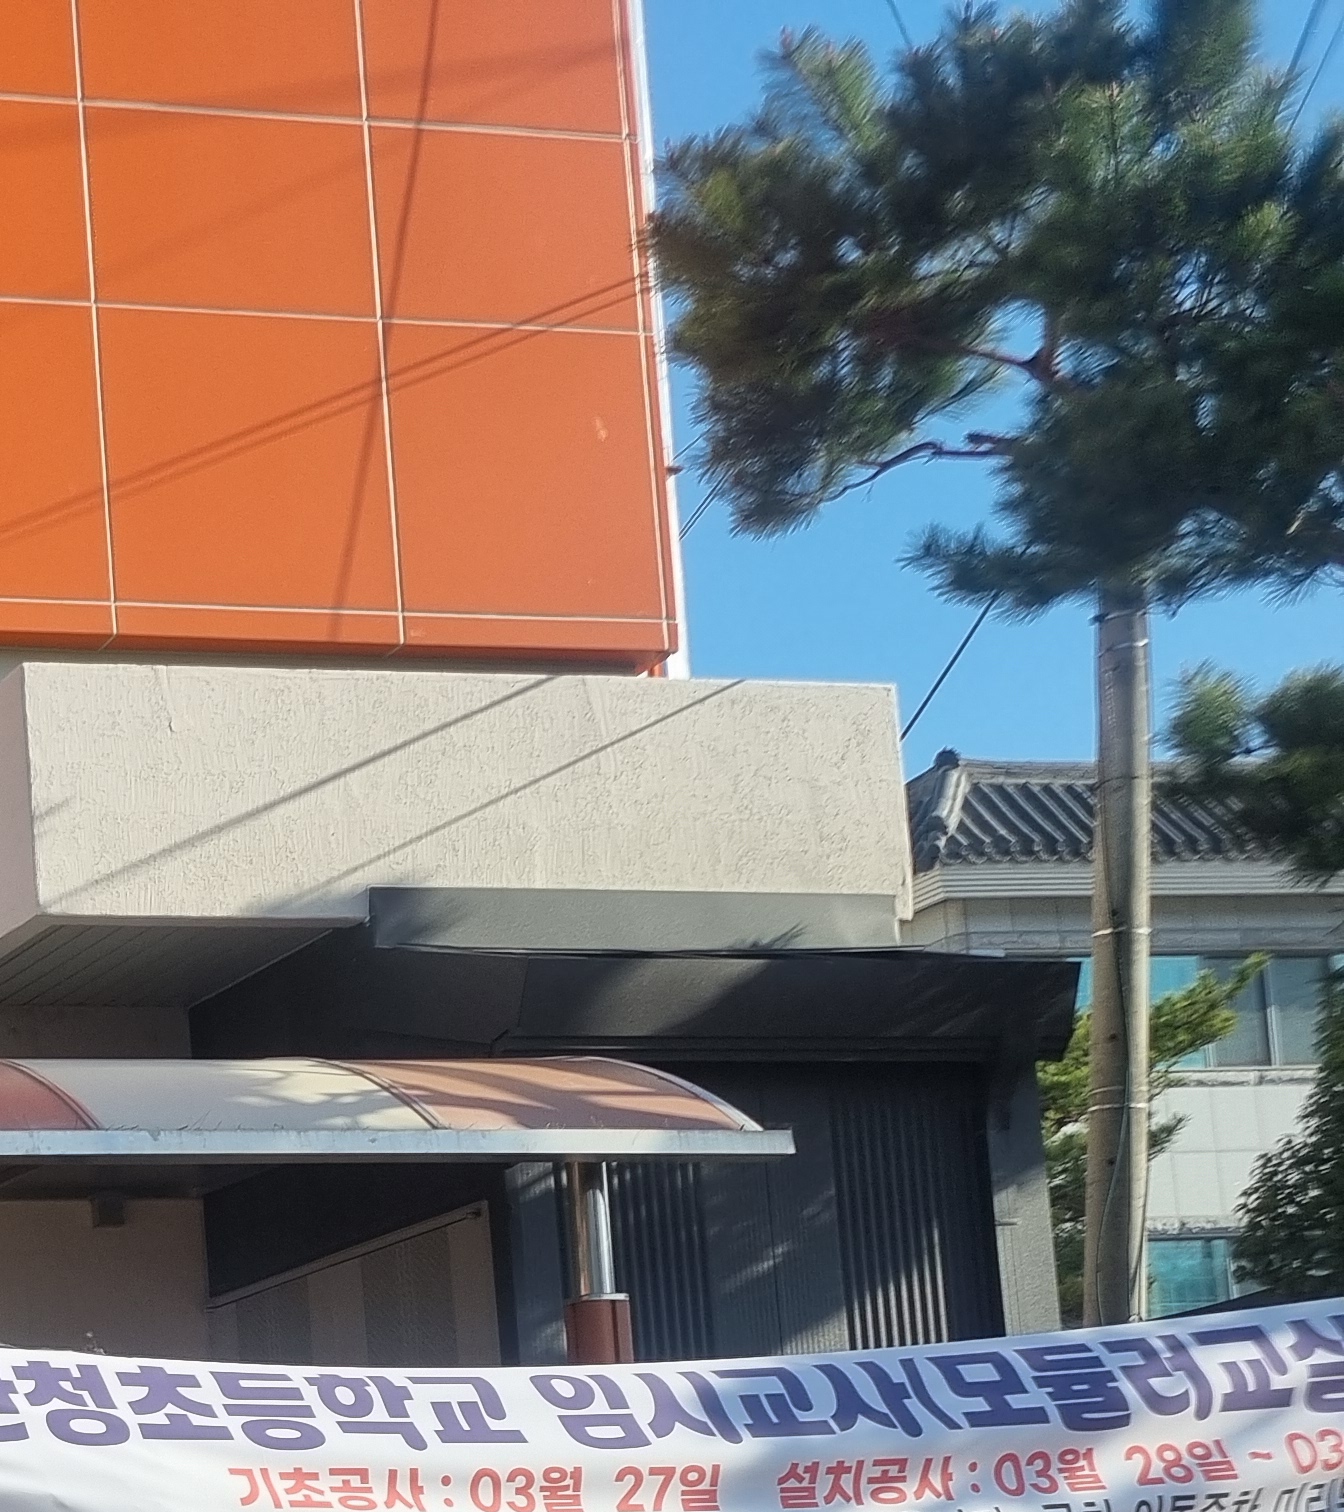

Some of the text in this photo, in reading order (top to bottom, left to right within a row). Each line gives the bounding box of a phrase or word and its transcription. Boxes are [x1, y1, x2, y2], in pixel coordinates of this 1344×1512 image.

[228, 1466, 427, 1512] 기초공사
[614, 1464, 721, 1512] 27일
[777, 1456, 955, 1510] 설치공사
[993, 1447, 1107, 1497] 03월
[1124, 1439, 1239, 1486] 28일
